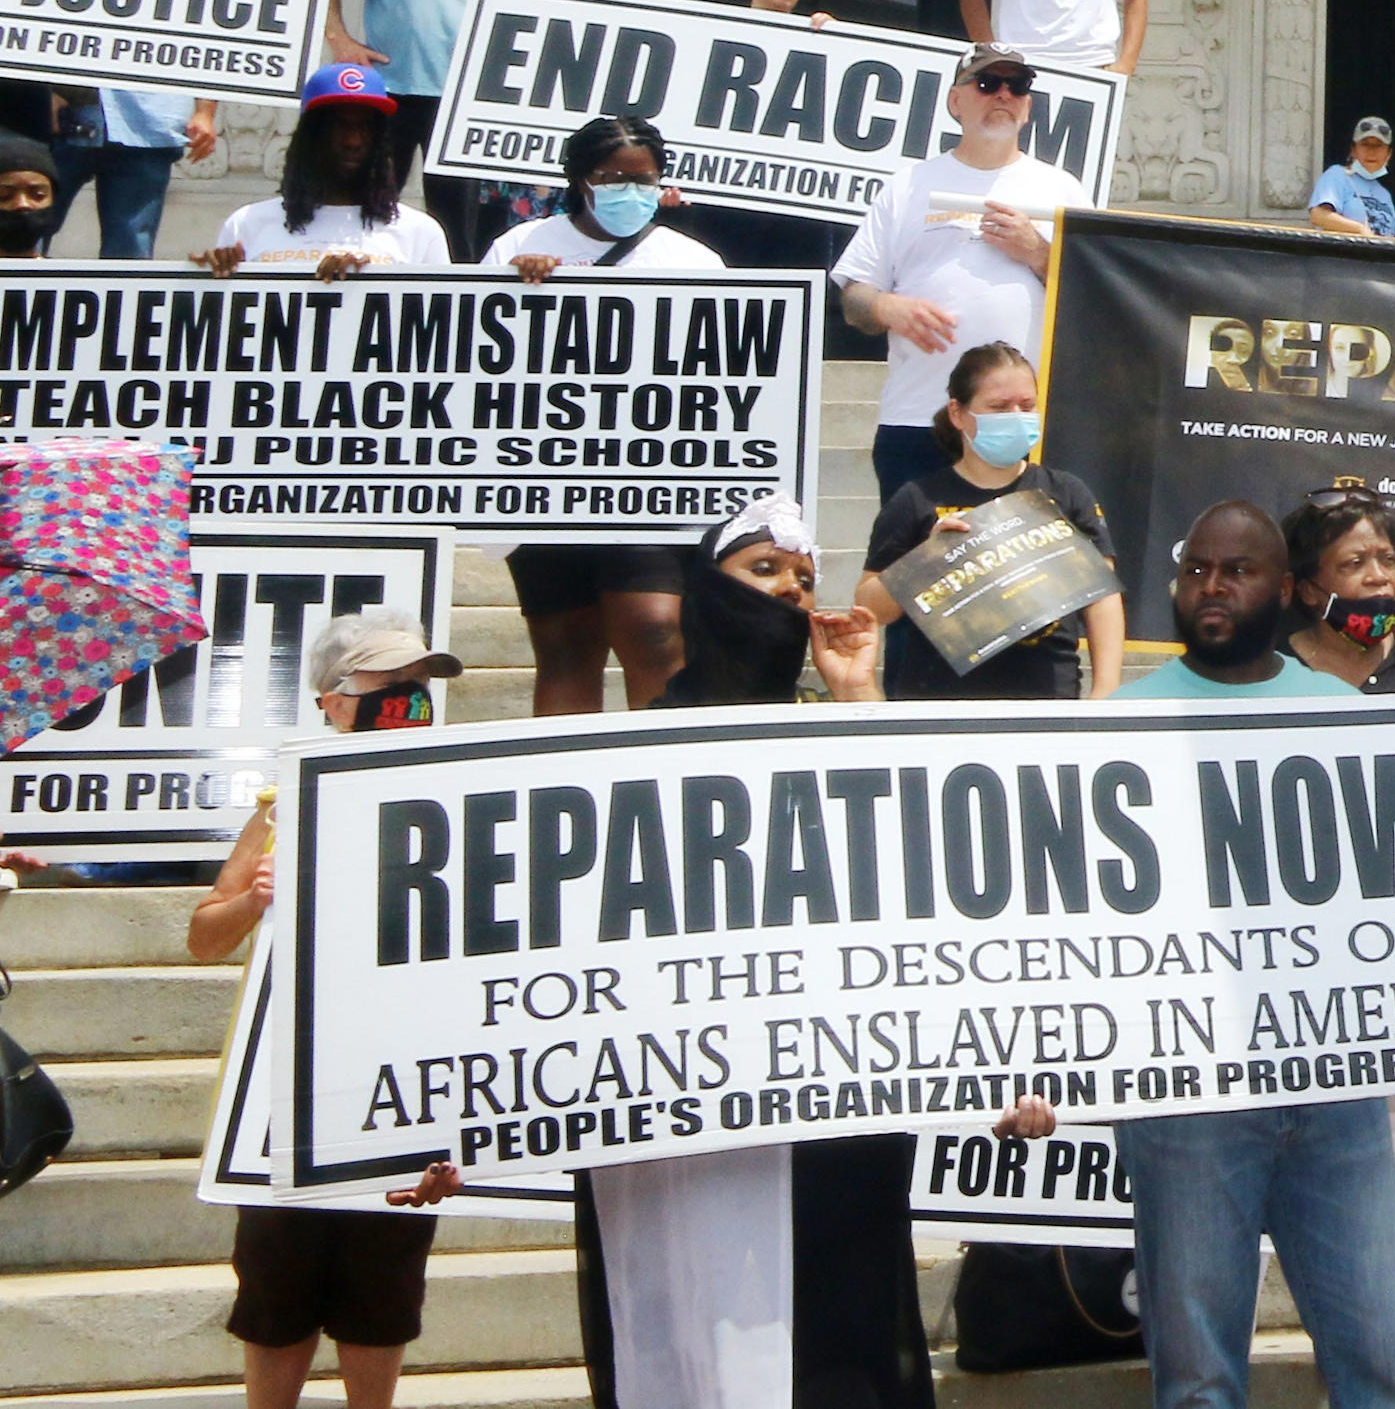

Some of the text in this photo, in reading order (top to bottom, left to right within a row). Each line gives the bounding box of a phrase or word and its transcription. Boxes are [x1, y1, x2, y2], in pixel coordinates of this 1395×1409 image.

[38, 30, 101, 58] FOR
[111, 38, 286, 78] PROGRESS
[474, 12, 1095, 180] END RACIM
[0, 289, 786, 378] MPLEMENT AMISTAD LAW
[0, 379, 763, 432] TEACH BLACK HISTORY
[1181, 420, 1226, 437] TAKE
[1227, 423, 1291, 441] ACTION
[1294, 427, 1328, 444] FOR
[1331, 430, 1345, 445] A
[1348, 432, 1387, 448] NEW
[253, 436, 478, 466] PUBLIC
[495, 437, 778, 469] SCHOOLS
[474, 485, 551, 515] FOR
[914, 518, 1075, 615] REPARATIONS
[944, 531, 991, 565] SAY THE
[10, 773, 109, 813] FOR
[377, 760, 1160, 968] REPARATIONS
[481, 966, 626, 1027] FOR
[658, 949, 806, 1004] THE
[838, 925, 1320, 991] DESCENDANTS
[361, 1024, 730, 1132] AFRICANS
[766, 1002, 1118, 1081] ENSLAVED
[1146, 996, 1216, 1058] IN
[460, 1097, 703, 1166] PEOPLE'S
[720, 1071, 1096, 1131] ORGANIZATION
[1114, 1065, 1201, 1104] FOR
[930, 1134, 1028, 1198] FOR
